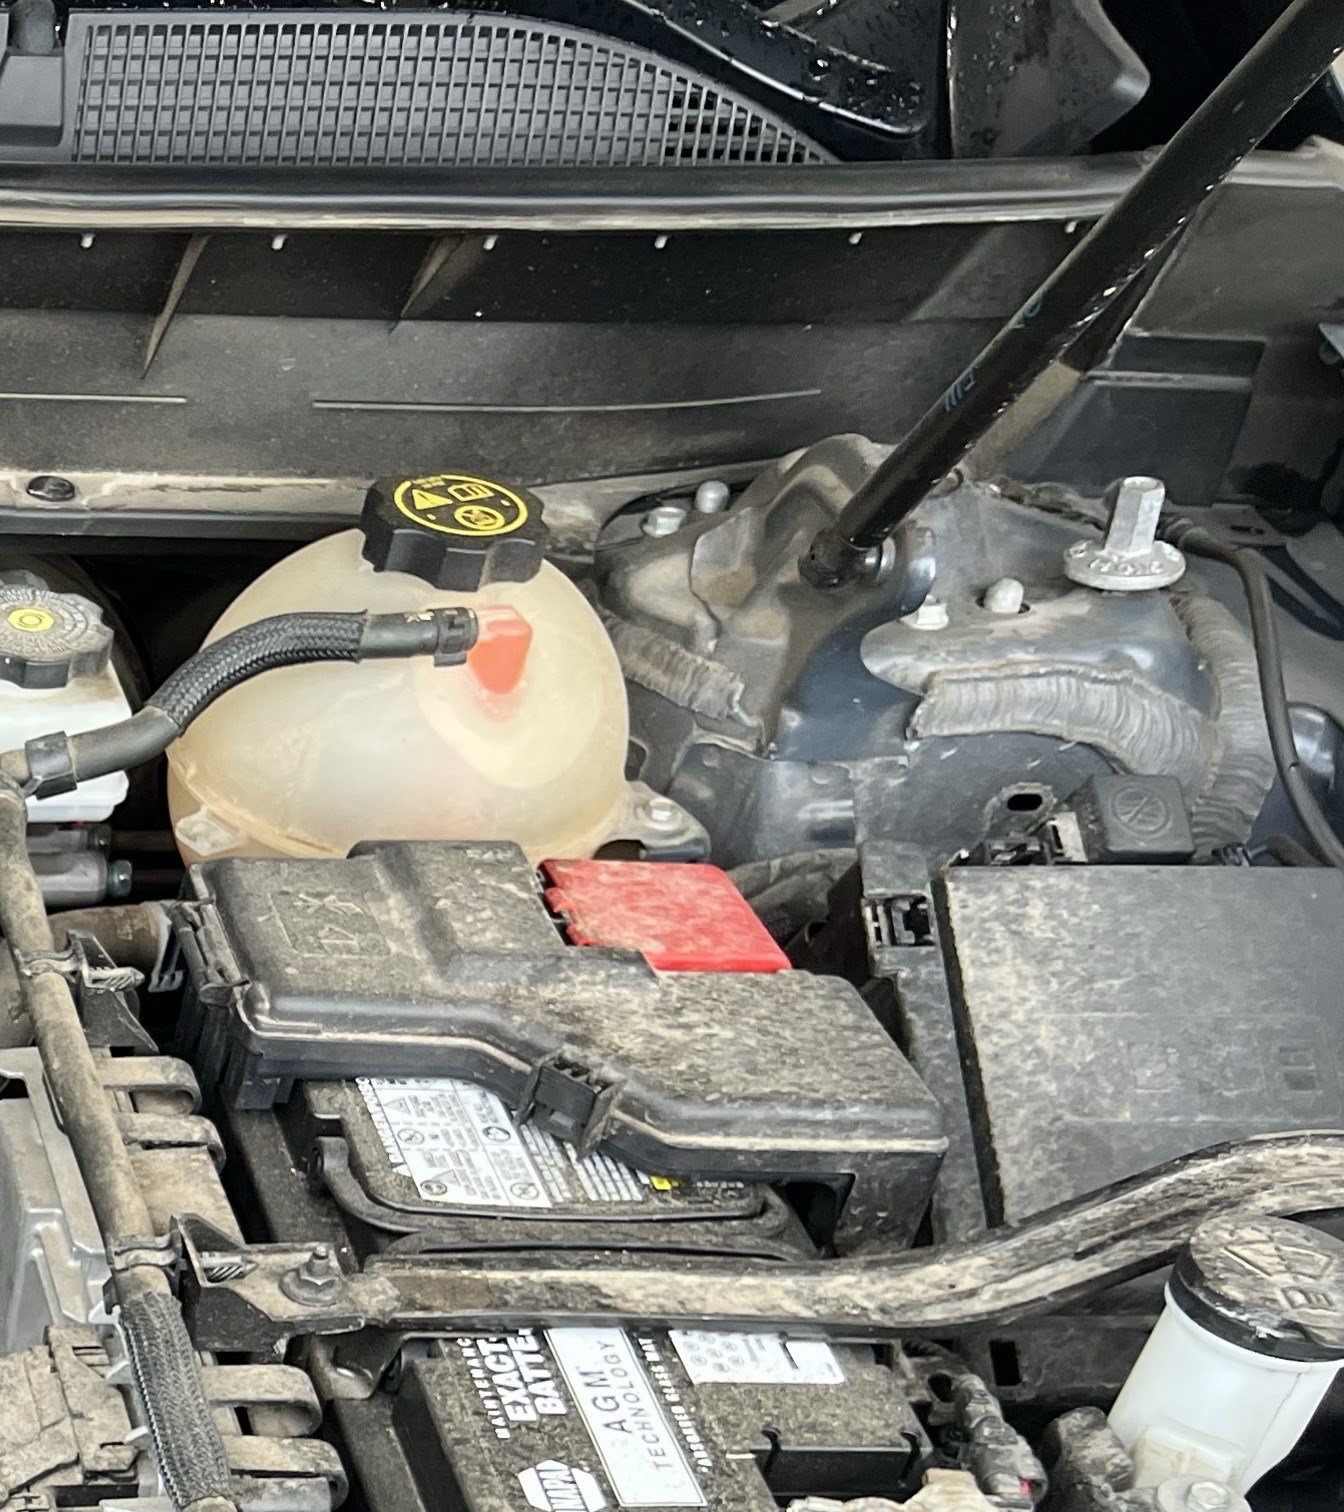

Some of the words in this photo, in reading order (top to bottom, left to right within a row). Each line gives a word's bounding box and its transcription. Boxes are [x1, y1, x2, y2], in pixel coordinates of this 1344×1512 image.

[578, 1369, 633, 1434] AGM
[597, 1340, 674, 1471] TECHNOLOGY
[539, 1466, 588, 1511] NAPA
